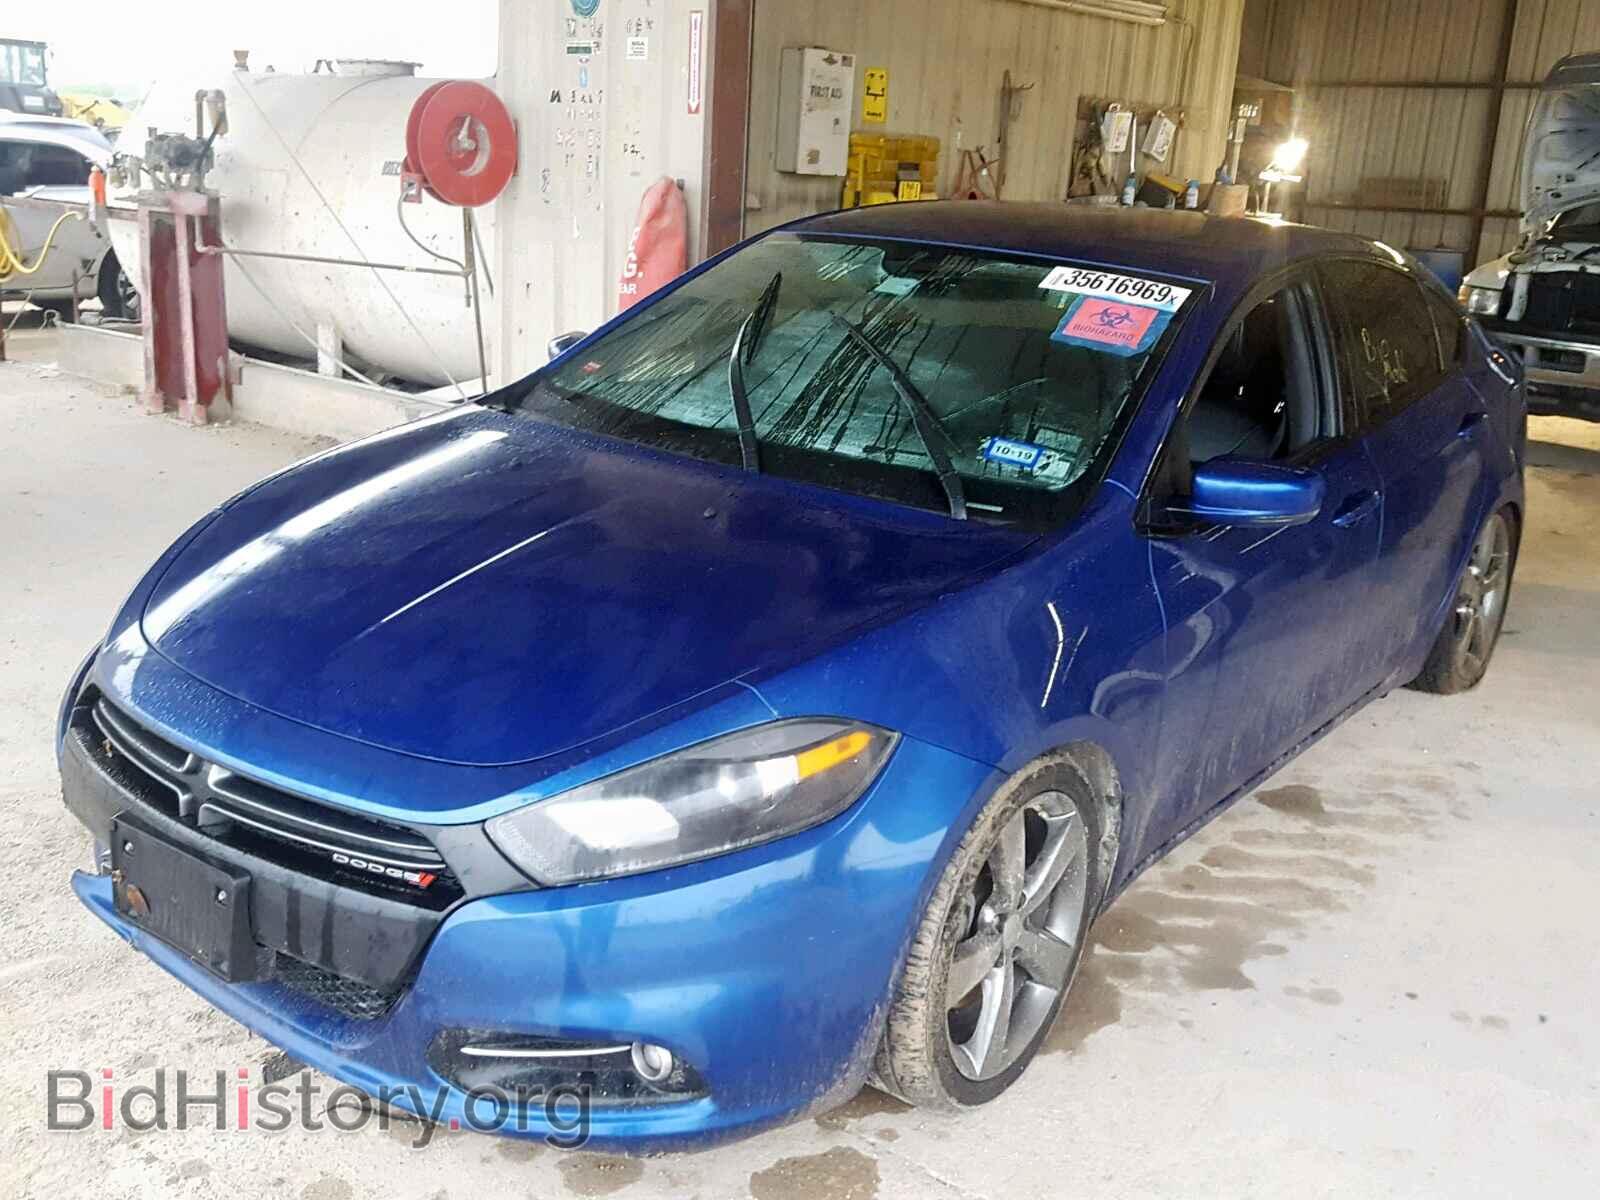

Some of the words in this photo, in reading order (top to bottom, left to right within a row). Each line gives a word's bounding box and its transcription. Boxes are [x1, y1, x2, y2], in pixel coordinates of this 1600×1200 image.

[1064, 270, 1172, 303] 35616969
[1073, 323, 1136, 341] BIOHAZARD
[332, 853, 421, 882] DODGE
